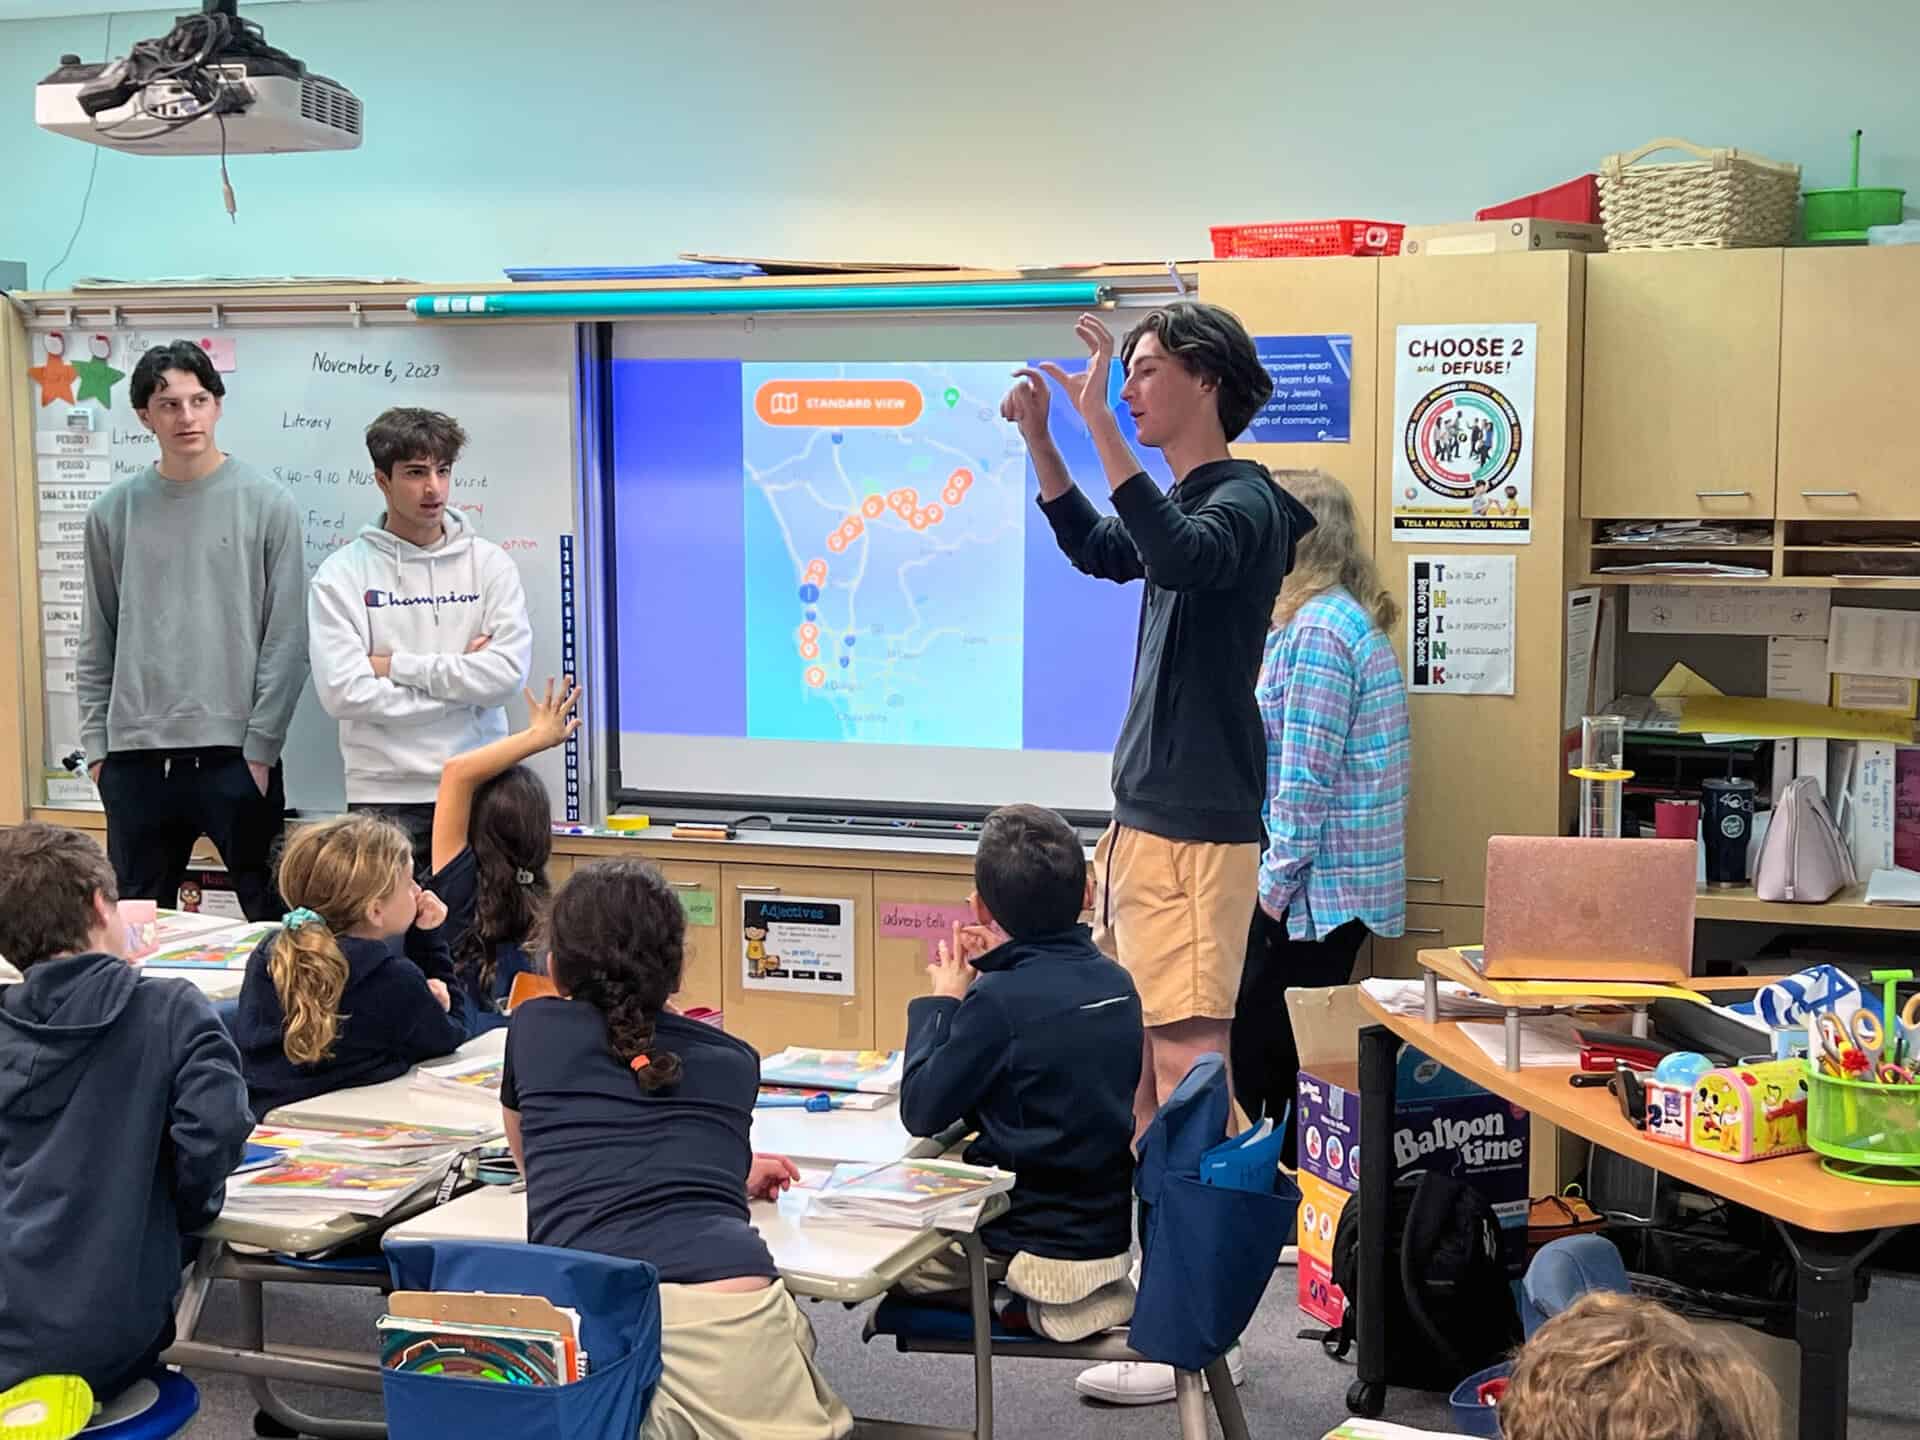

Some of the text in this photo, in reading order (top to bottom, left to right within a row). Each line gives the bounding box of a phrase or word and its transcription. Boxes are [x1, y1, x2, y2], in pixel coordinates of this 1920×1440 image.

[1408, 337, 1524, 358] CHOOSE 2
[311, 351, 441, 383] November 6, 2023
[1308, 361, 1332, 370] each
[1416, 360, 1512, 375] and DEFUSE!
[1279, 375, 1302, 384] learn
[1303, 375, 1316, 384] for
[1276, 389, 1322, 399] by Jewish
[805, 396, 907, 410] STANDARD VIEW
[1267, 402, 1329, 412] and rooted in
[282, 410, 332, 431] Literacy
[1271, 416, 1281, 425] of
[1402, 519, 1424, 528] TELL
[1425, 519, 1439, 528] AN
[1469, 519, 1488, 528] YOU
[363, 588, 481, 612] Champion
[760, 903, 825, 920] Adjectives
[1393, 1112, 1505, 1169] Balloon
[1460, 1137, 1523, 1166] time
